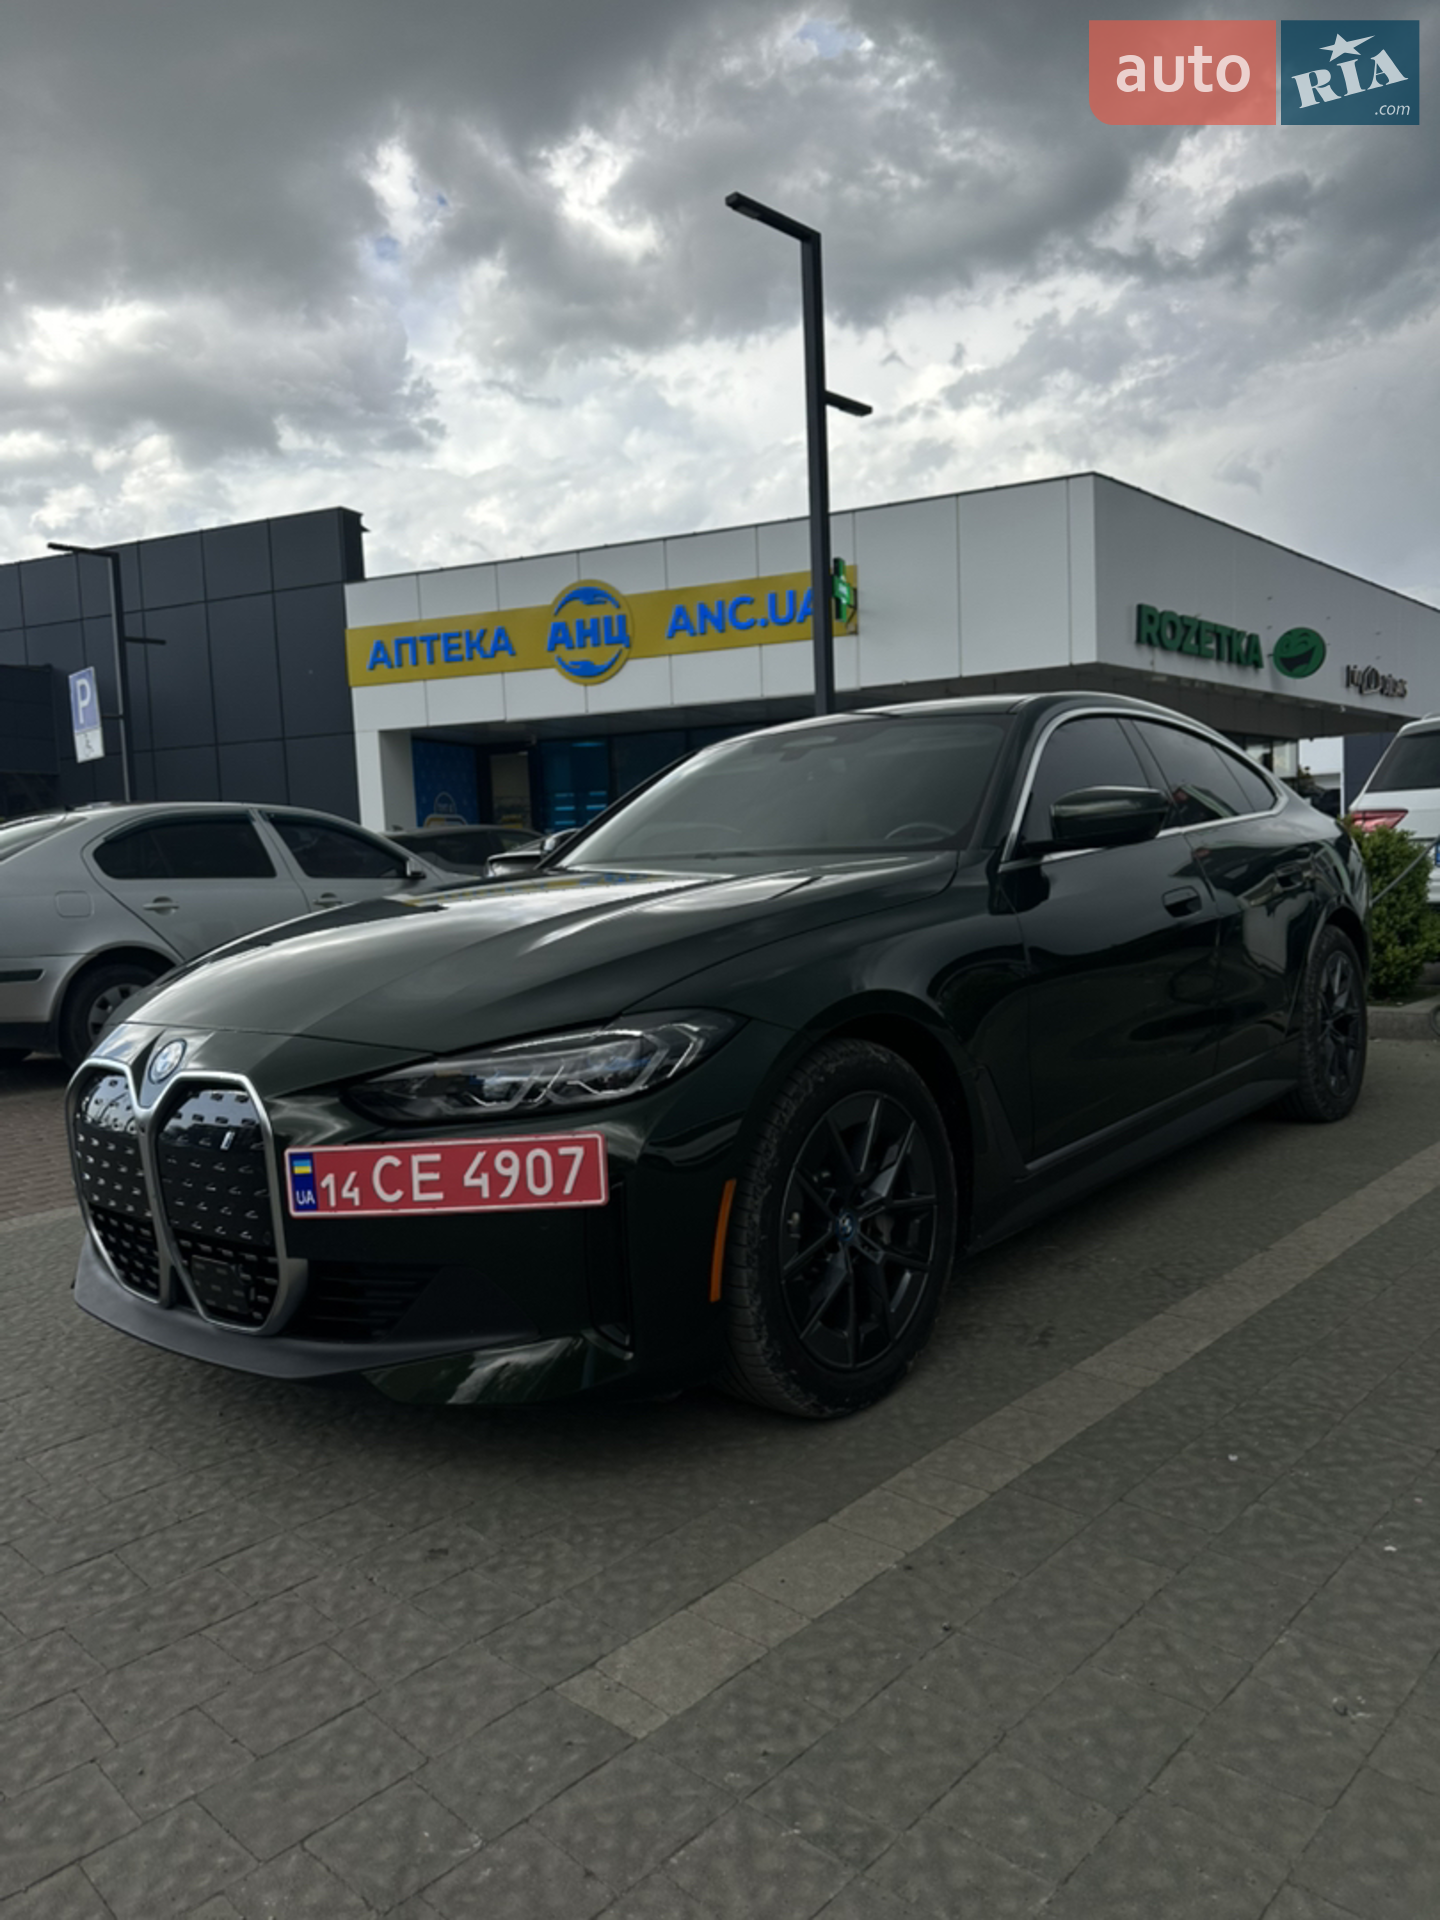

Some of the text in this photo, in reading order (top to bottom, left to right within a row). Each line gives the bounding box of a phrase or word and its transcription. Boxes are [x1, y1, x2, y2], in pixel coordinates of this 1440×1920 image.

[366, 626, 516, 671] АПТЕКА
[547, 614, 631, 652] АНЦ
[1135, 603, 1264, 669] ROZETKA
[76, 678, 92, 725] P
[295, 1190, 316, 1206] UA
[320, 1146, 584, 1207] 14 CE 4907
